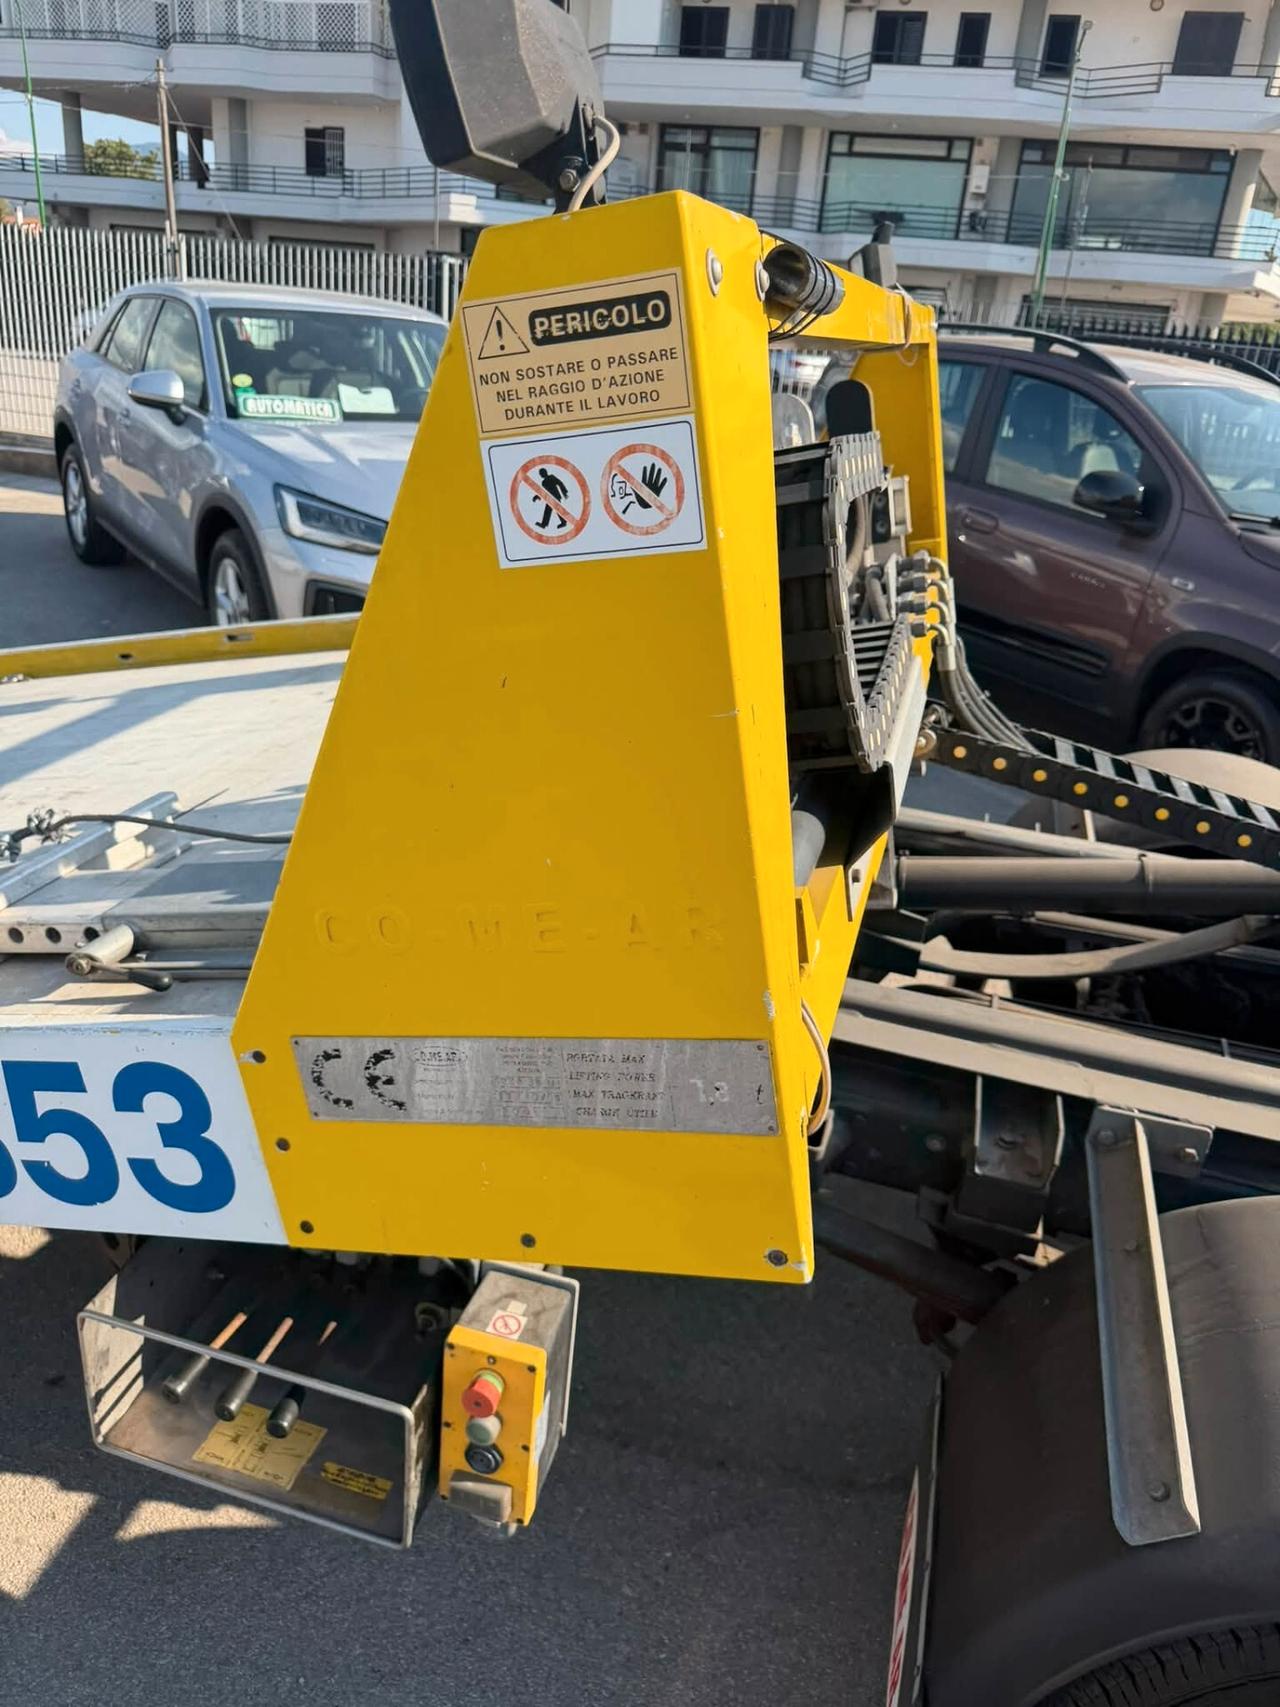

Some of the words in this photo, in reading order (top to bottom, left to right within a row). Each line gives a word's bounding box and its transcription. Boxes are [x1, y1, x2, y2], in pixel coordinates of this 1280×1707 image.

[533, 298, 666, 339] PERICOLO
[479, 370, 510, 386] NON
[516, 360, 585, 381] SOSTARE
[591, 358, 601, 370] O
[608, 347, 678, 369] PASSARE
[496, 389, 523, 403] NEL
[528, 380, 586, 399] RAGGIO
[592, 369, 665, 390] D'AZIONE
[246, 398, 334, 418] AUTOMATICA
[505, 400, 574, 421] DURANTE
[580, 399, 592, 412] IL
[598, 390, 660, 409] LAVORO
[0, 1060, 236, 1214] 53
